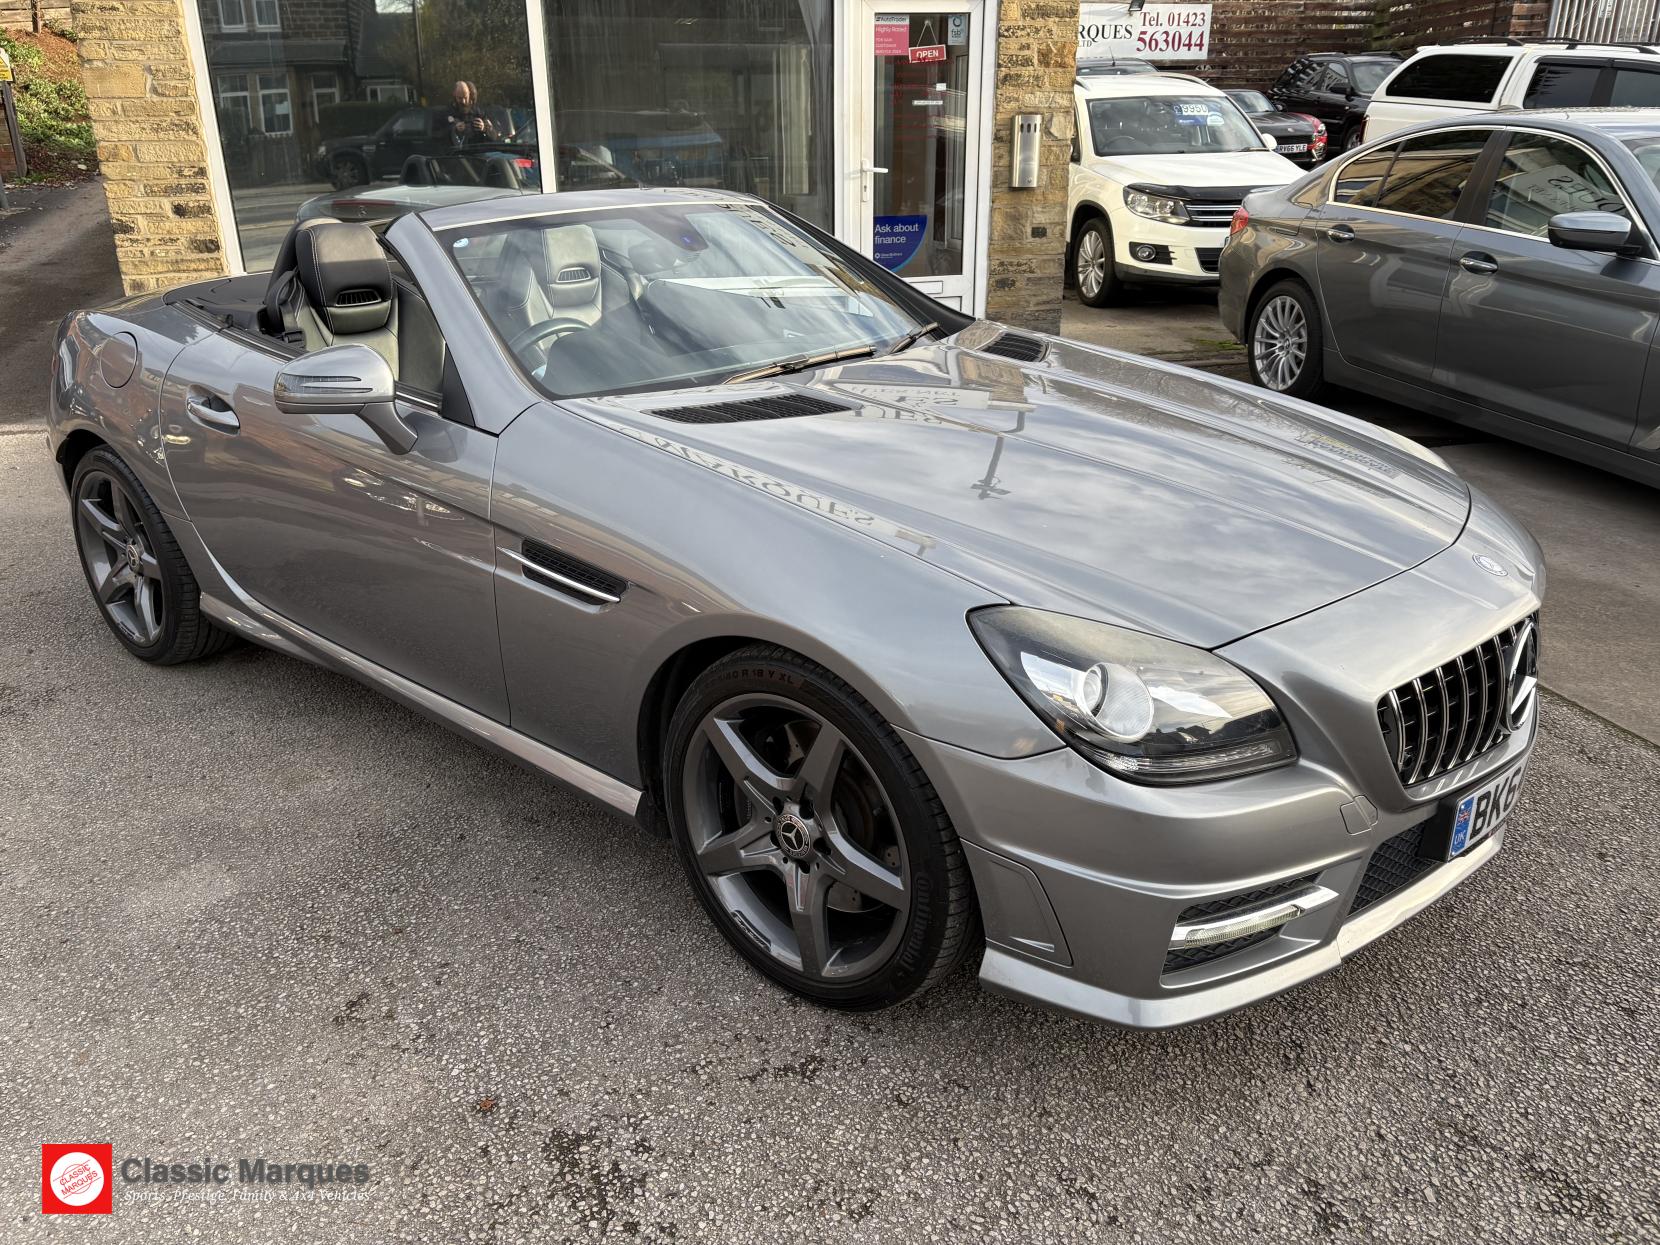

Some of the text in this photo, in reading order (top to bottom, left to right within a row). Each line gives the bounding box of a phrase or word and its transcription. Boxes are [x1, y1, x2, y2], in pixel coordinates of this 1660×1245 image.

[1140, 12, 1206, 27] Tel. 01423
[1136, 30, 1204, 52] 563044
[916, 50, 939, 59] OPEN
[874, 223, 919, 233] Ask about
[874, 236, 907, 244] finance
[1469, 766, 1523, 842] BK6
[1454, 829, 1467, 845] UK
